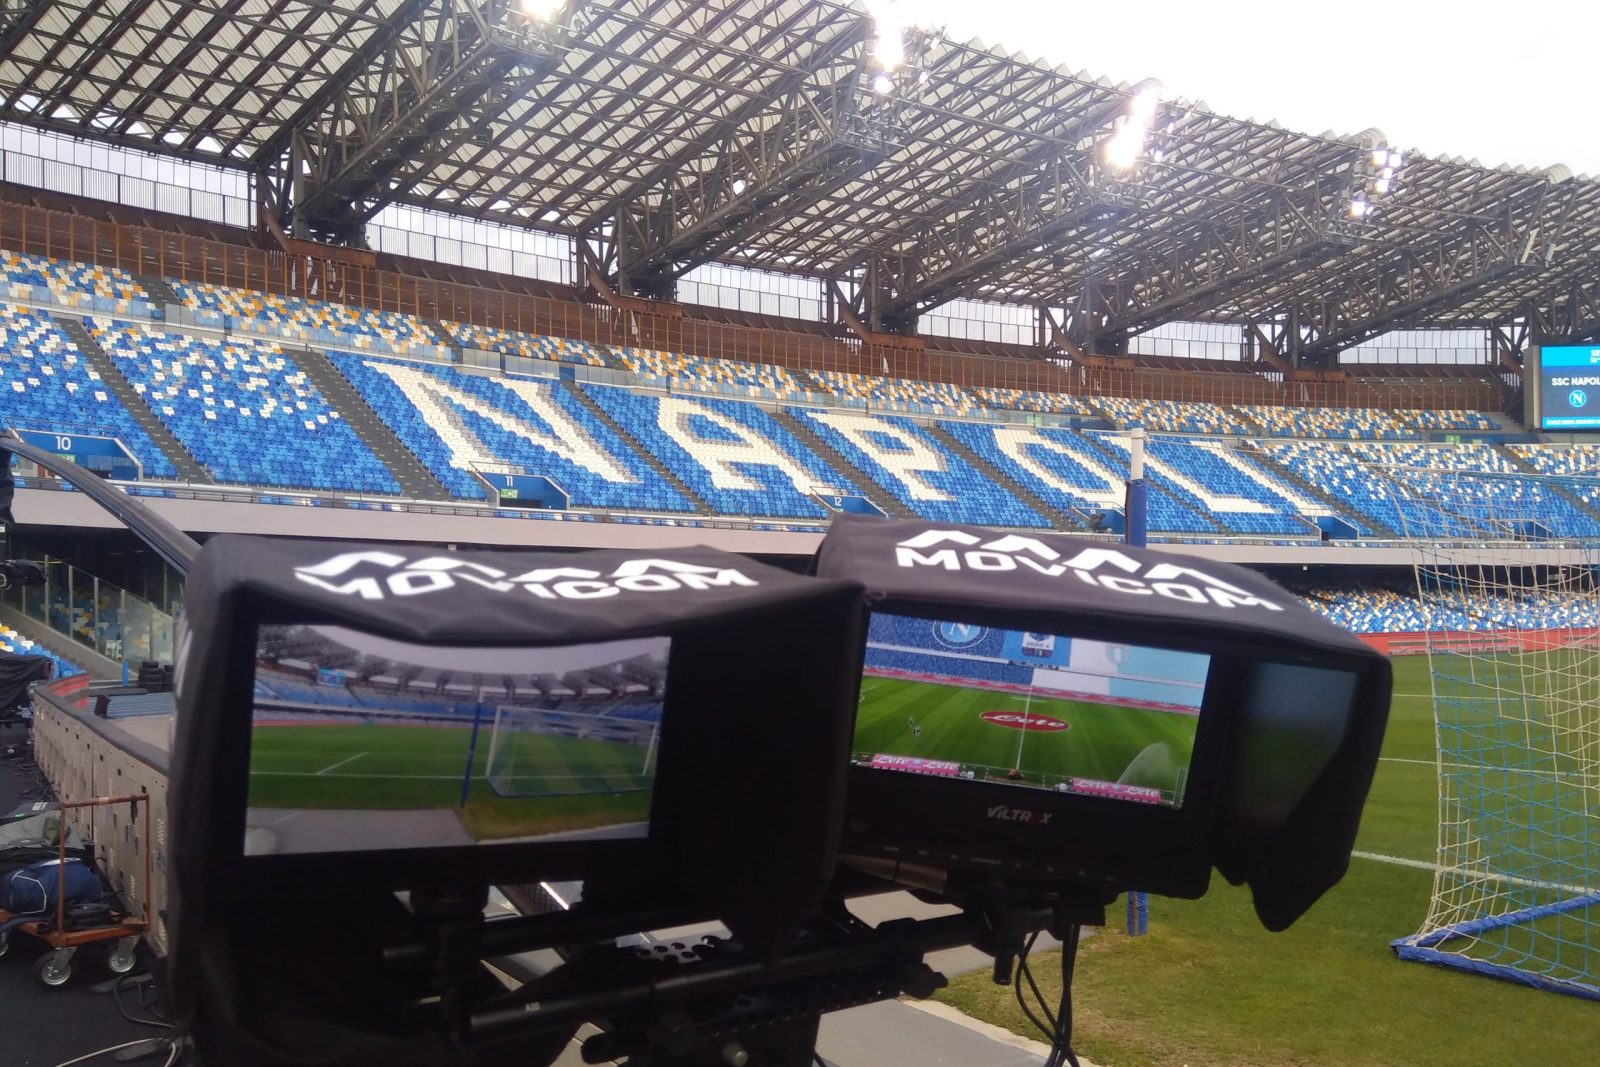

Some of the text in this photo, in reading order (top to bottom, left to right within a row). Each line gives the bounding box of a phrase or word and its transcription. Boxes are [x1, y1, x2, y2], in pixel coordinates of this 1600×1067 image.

[1551, 377, 1570, 386] SSC
[55, 435, 72, 451] 10
[505, 475, 514, 487] 11
[834, 496, 843, 507] 12
[294, 567, 759, 600] MOVICOM
[894, 546, 1285, 611] MOVICOM
